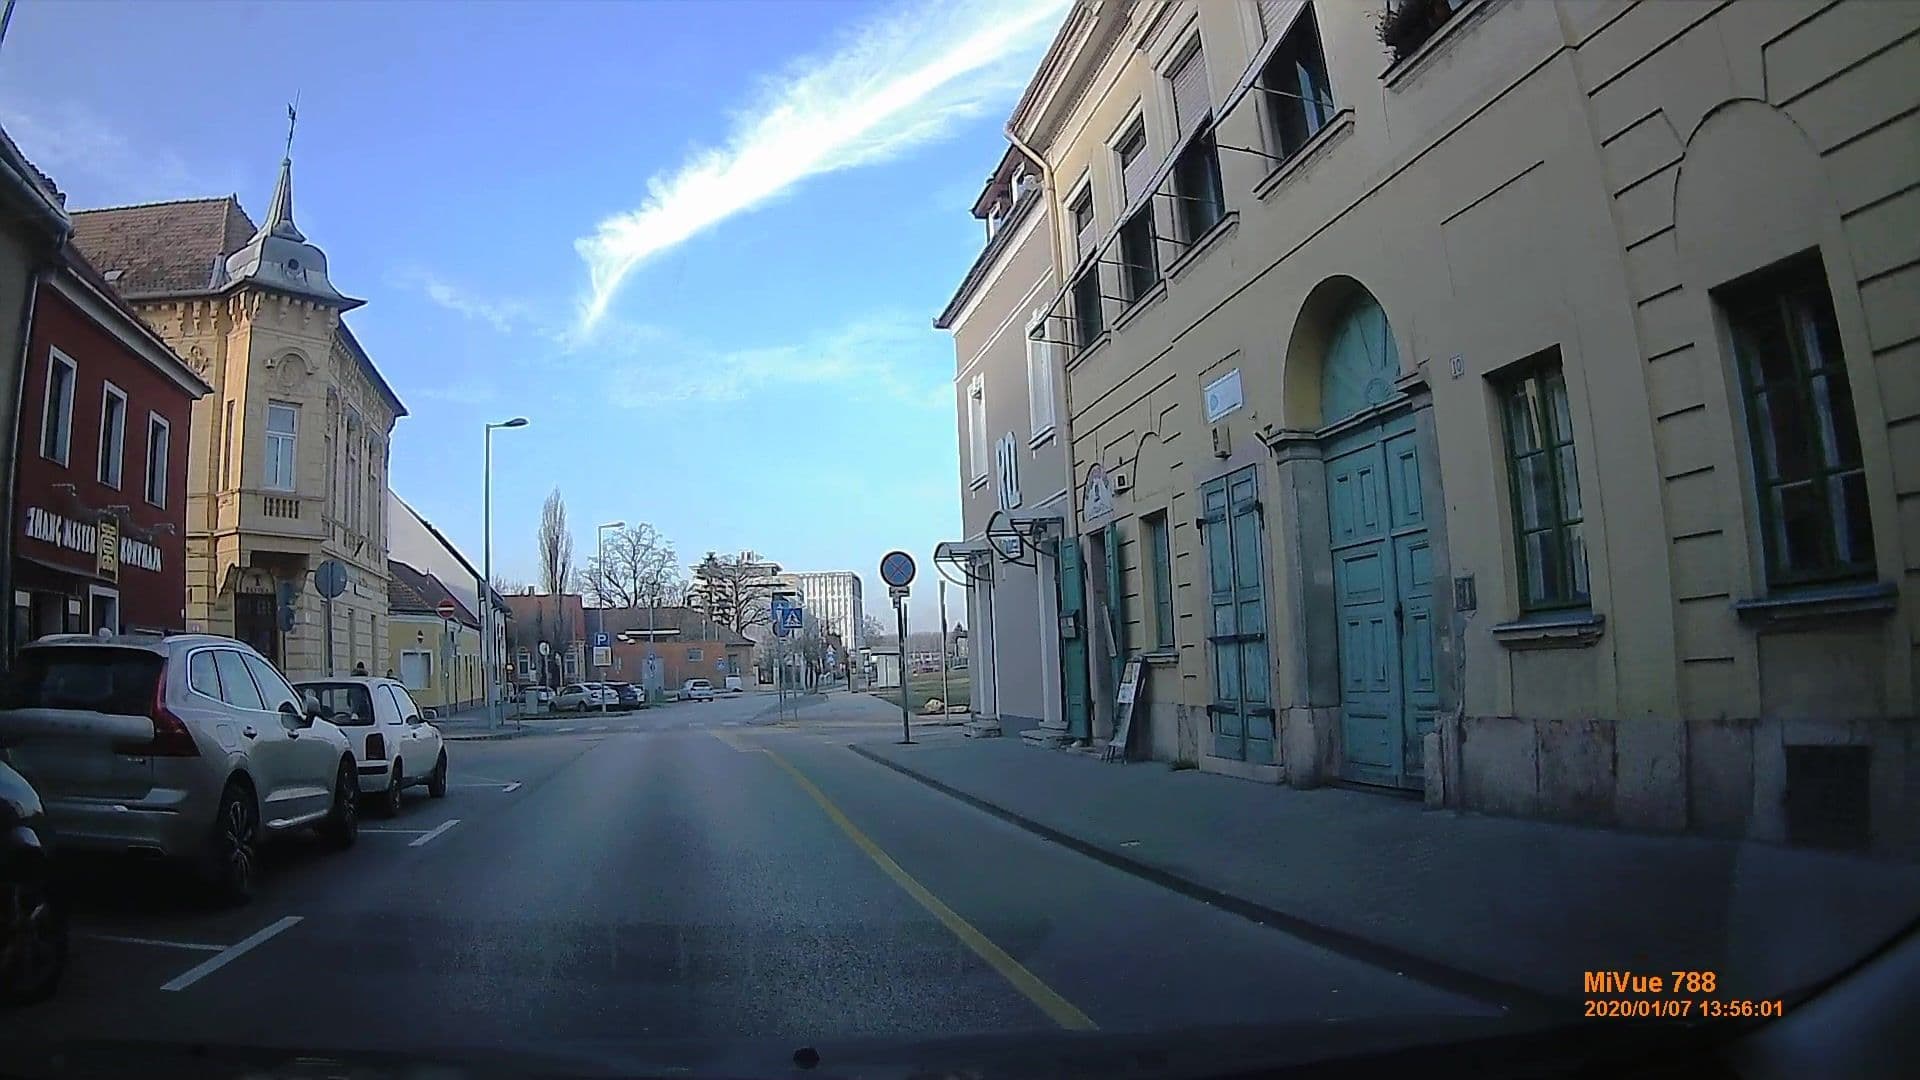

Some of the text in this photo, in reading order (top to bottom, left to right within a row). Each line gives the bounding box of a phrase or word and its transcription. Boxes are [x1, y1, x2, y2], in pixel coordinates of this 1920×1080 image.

[1452, 358, 1463, 374] 10
[26, 506, 62, 548] ZHANG
[62, 518, 96, 554] MESTER
[598, 634, 606, 645] P
